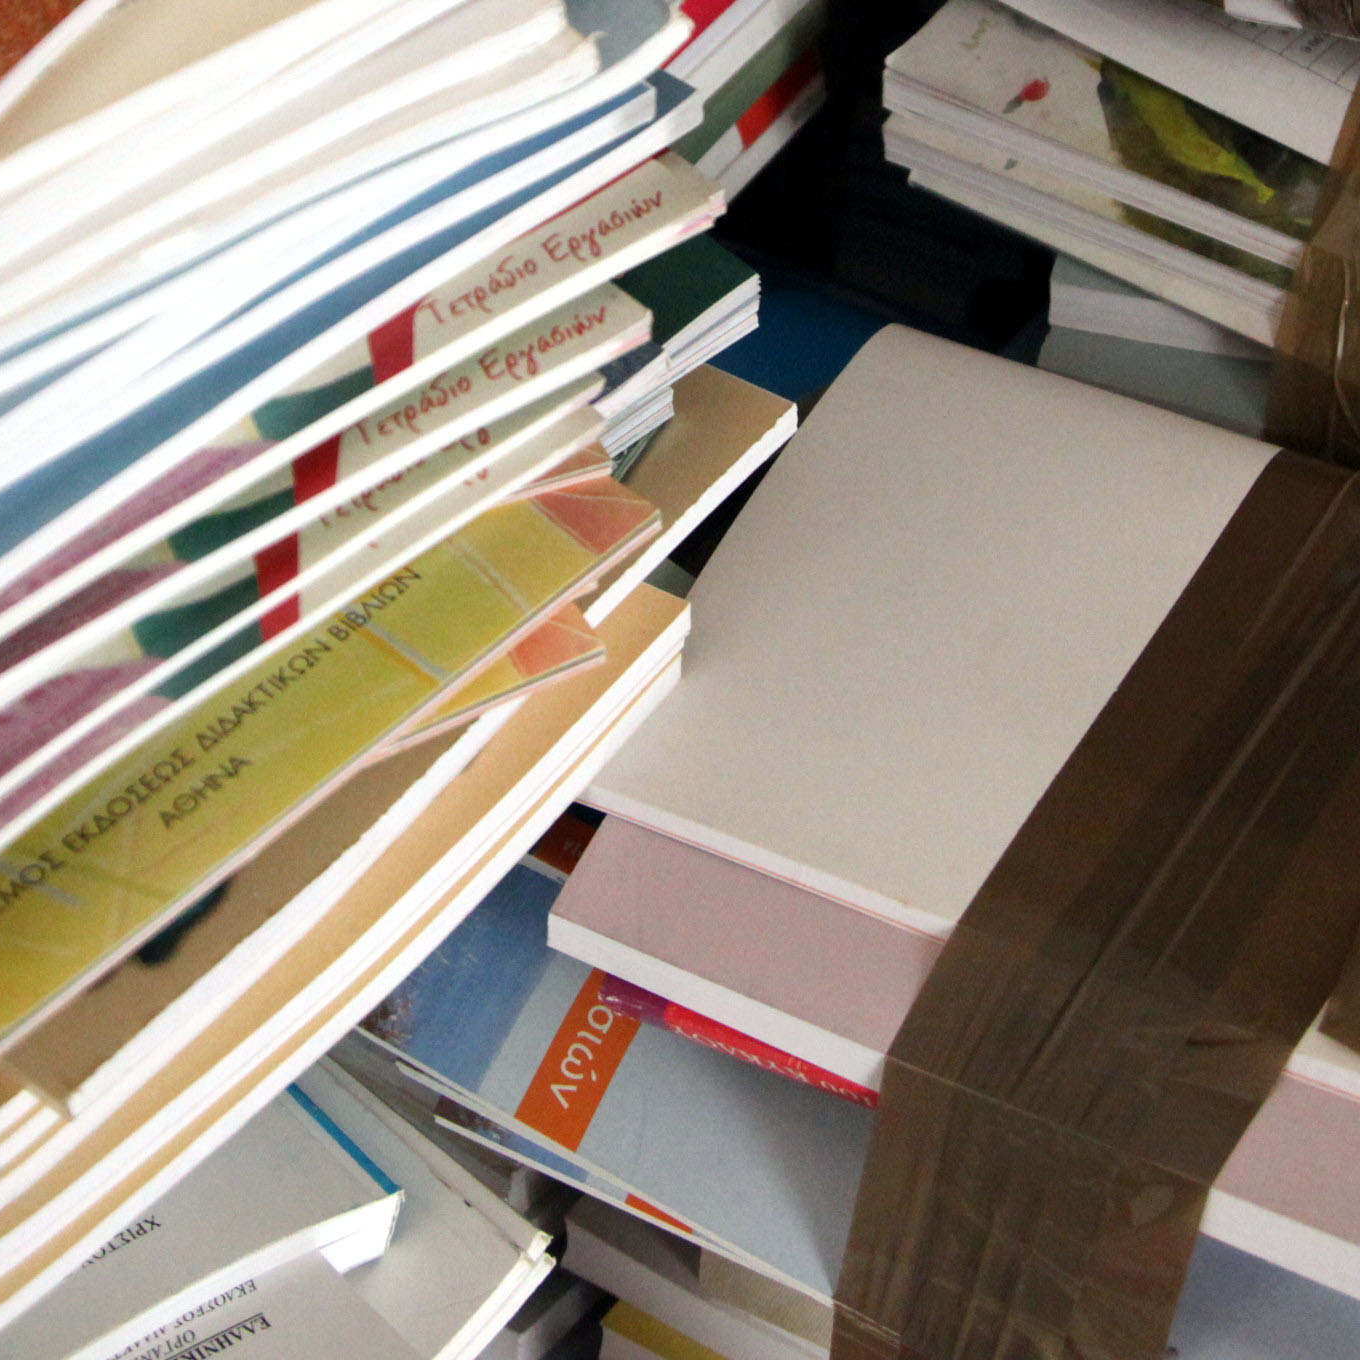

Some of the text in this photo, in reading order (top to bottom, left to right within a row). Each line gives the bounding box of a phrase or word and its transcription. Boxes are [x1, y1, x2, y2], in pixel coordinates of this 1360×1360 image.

[417, 187, 666, 327] Τετράδιο Εργασιών
[340, 304, 608, 448] Τετράδιο Εργασιών
[60, 747, 197, 855] ΕΚΔΟΣΕΩΣ
[194, 639, 333, 751] ΔΙΔΑΚΤΙΚΩΝ
[326, 564, 424, 645] ΒΙΒΛΙΩΝ
[156, 752, 252, 830] ΑΘΗΝΑ
